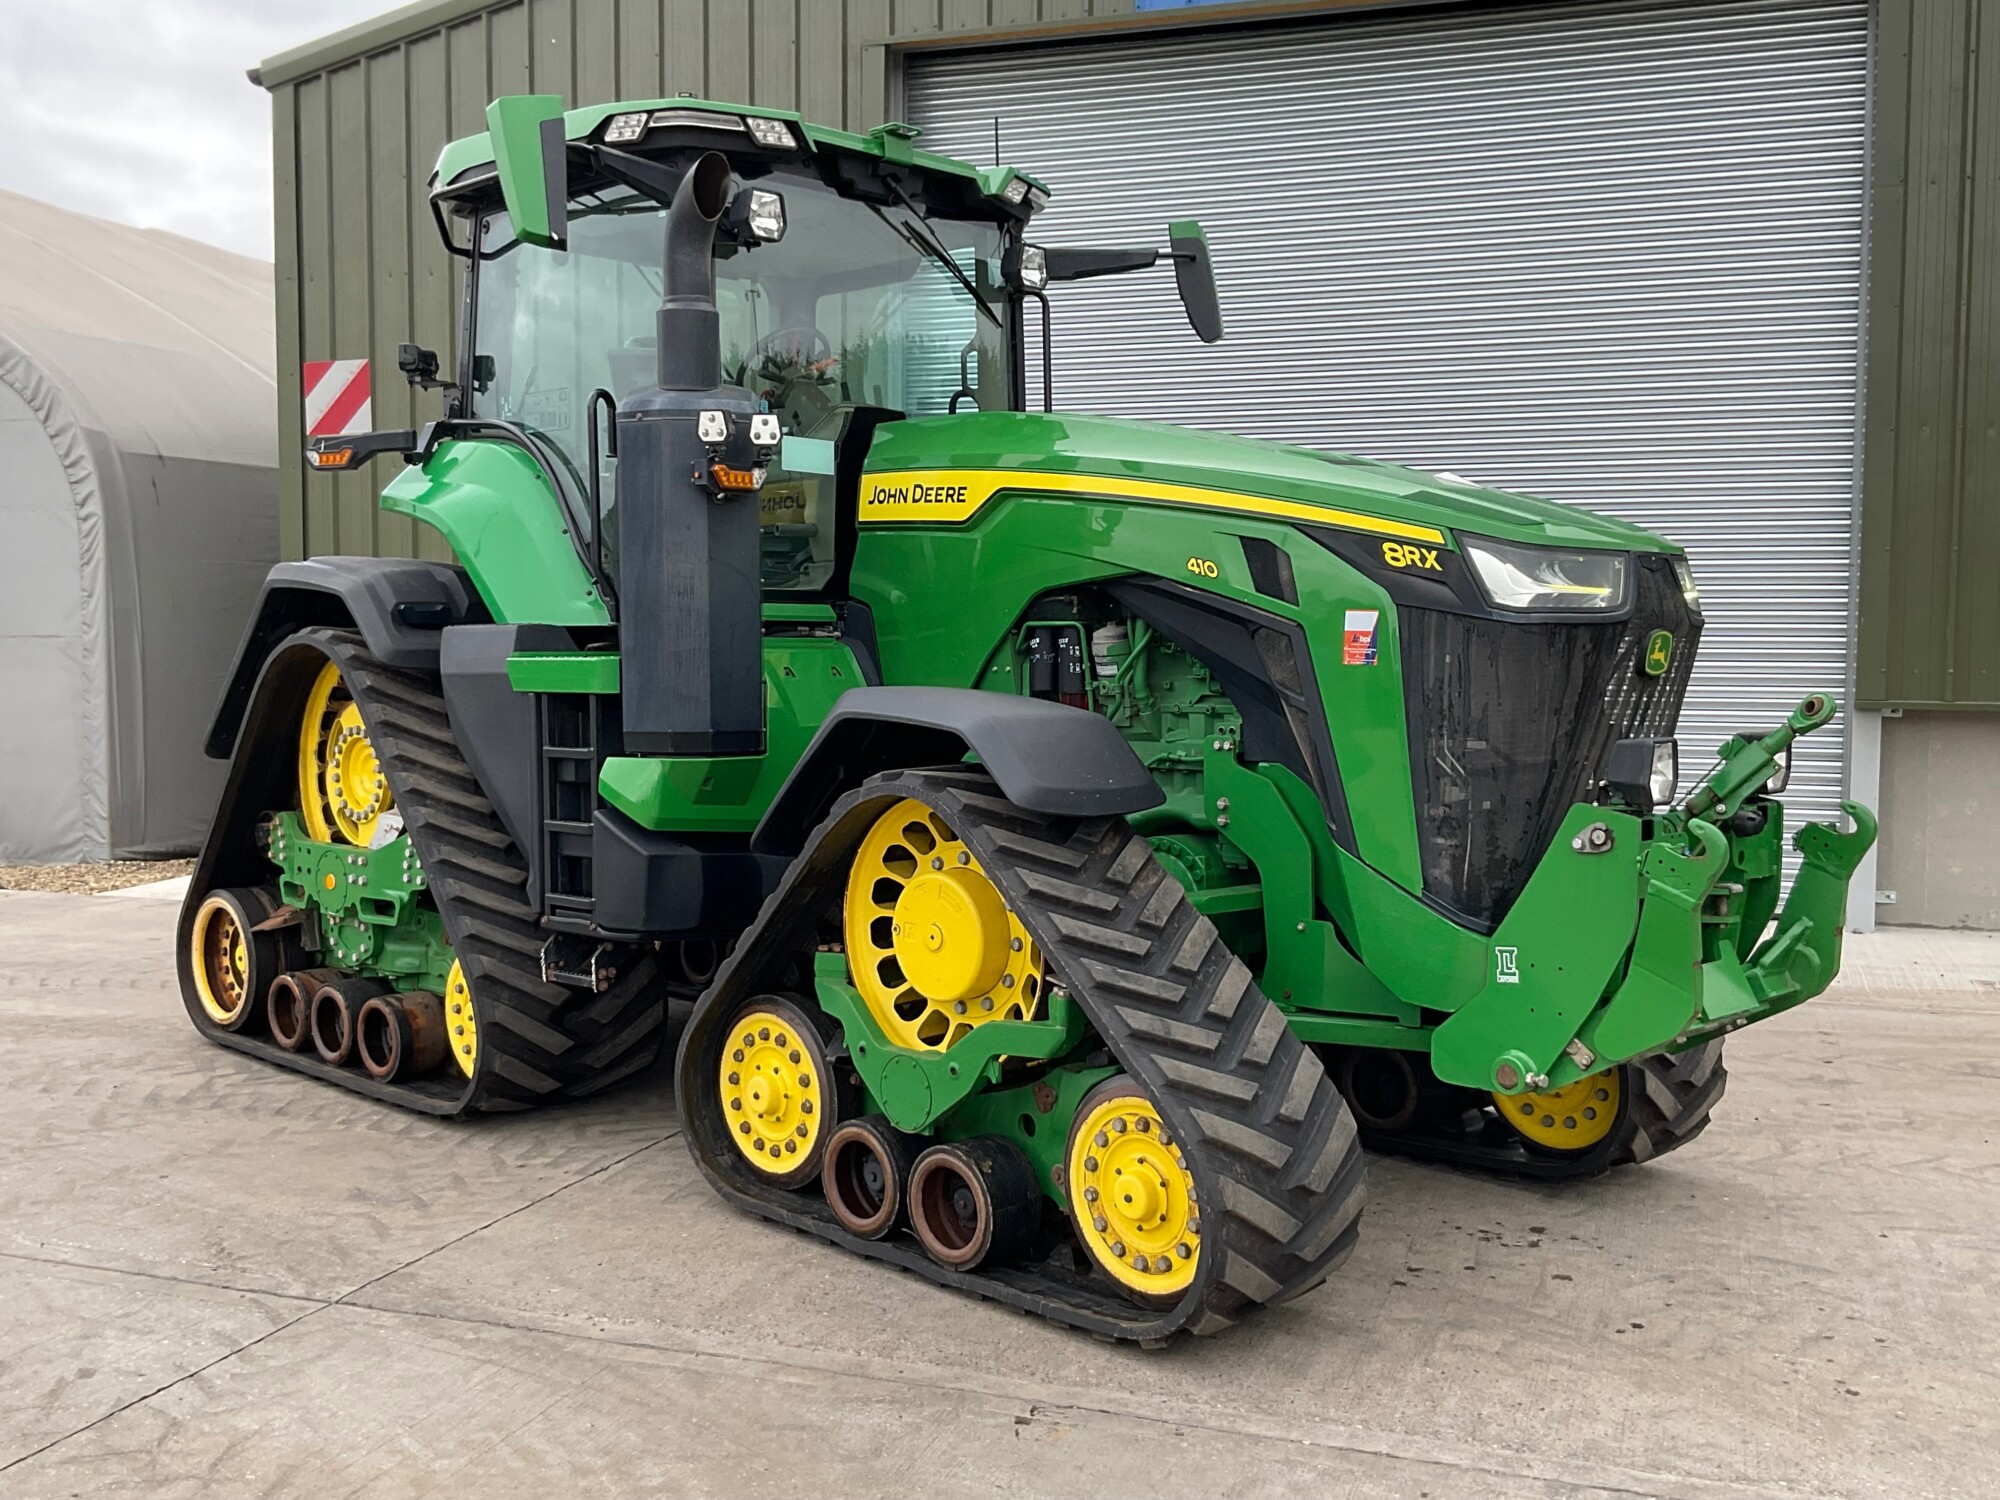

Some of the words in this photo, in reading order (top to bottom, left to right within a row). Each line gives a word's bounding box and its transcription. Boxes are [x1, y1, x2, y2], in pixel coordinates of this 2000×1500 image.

[868, 485, 908, 504] JOHN
[912, 484, 967, 503] DEERE
[1382, 542, 1443, 571] 8RX
[1187, 557, 1218, 578] 410
